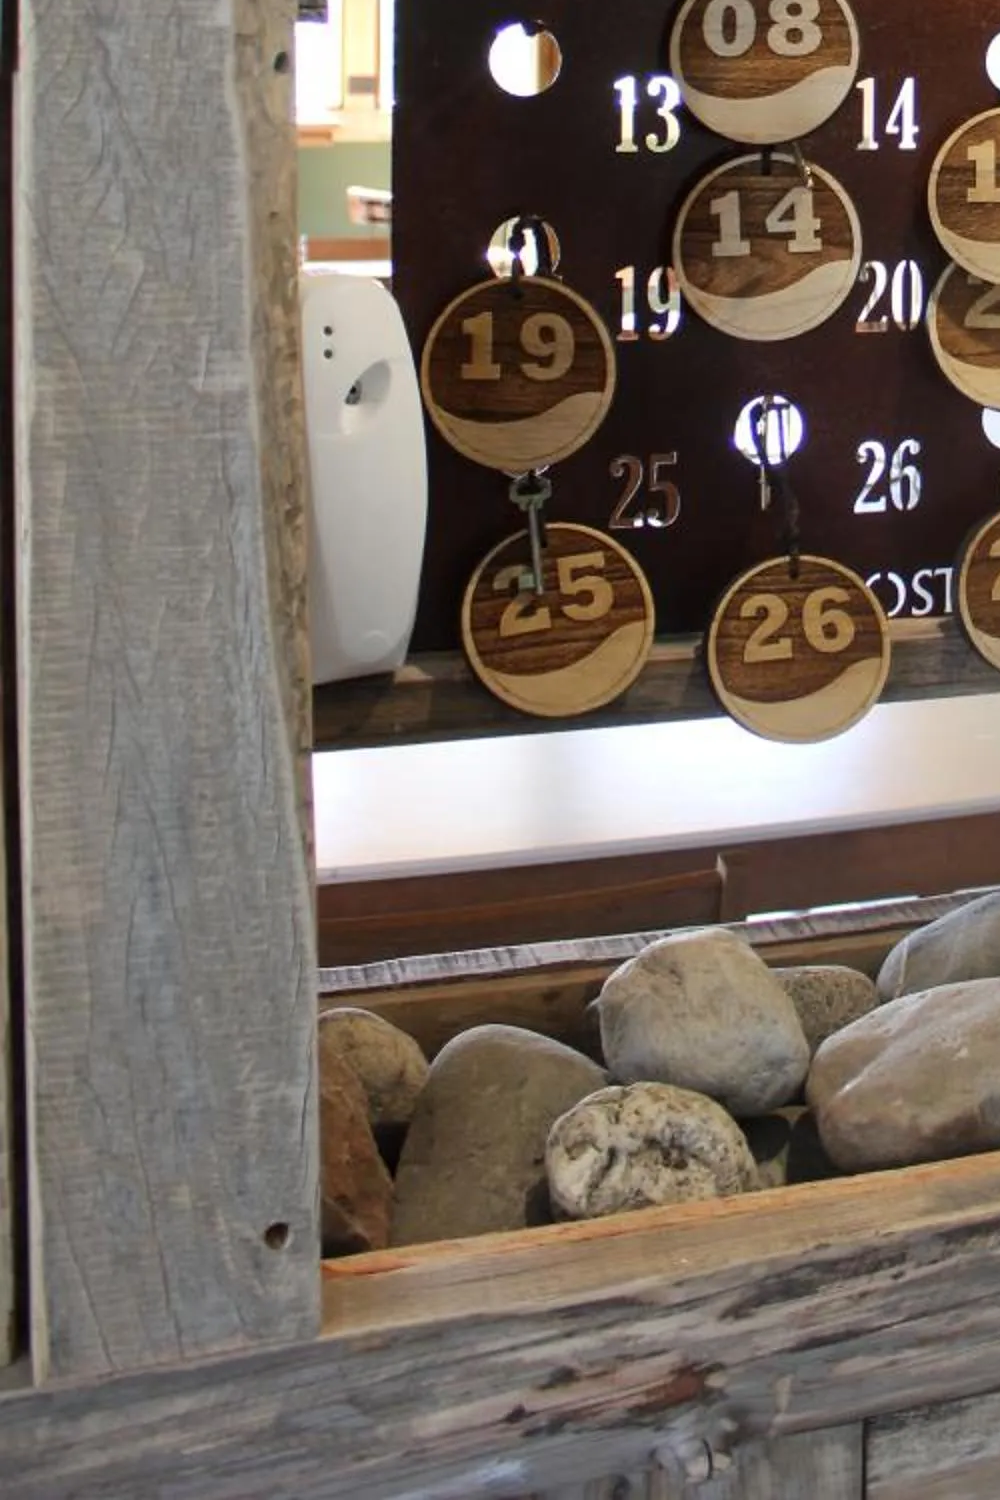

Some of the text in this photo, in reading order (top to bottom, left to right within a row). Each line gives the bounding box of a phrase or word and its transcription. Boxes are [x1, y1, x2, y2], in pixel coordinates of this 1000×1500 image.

[613, 75, 682, 153] 13
[856, 76, 919, 151] 14
[709, 185, 824, 258] 14
[613, 265, 682, 341] 19
[855, 259, 923, 333] 20
[460, 311, 575, 383] 19
[608, 451, 682, 530] 25
[853, 438, 922, 514] 26
[493, 550, 615, 637] 25
[740, 585, 857, 664] 26
